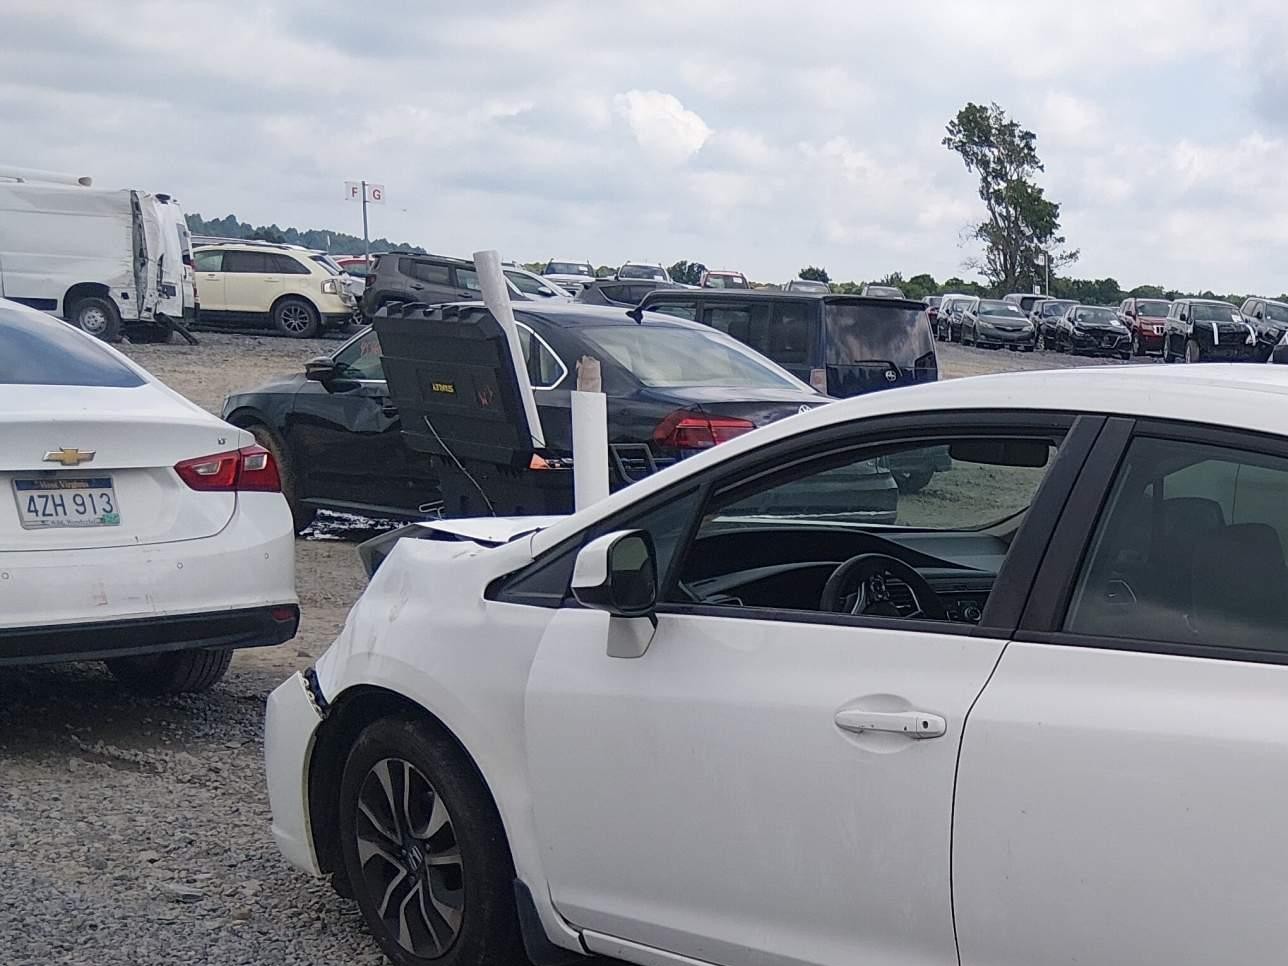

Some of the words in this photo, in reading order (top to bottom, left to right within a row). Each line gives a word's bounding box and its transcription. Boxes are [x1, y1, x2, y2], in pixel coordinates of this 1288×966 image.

[351, 187, 358, 198] F
[372, 189, 381, 200] G
[27, 494, 67, 517] 4ZH
[72, 492, 113, 515] 913
